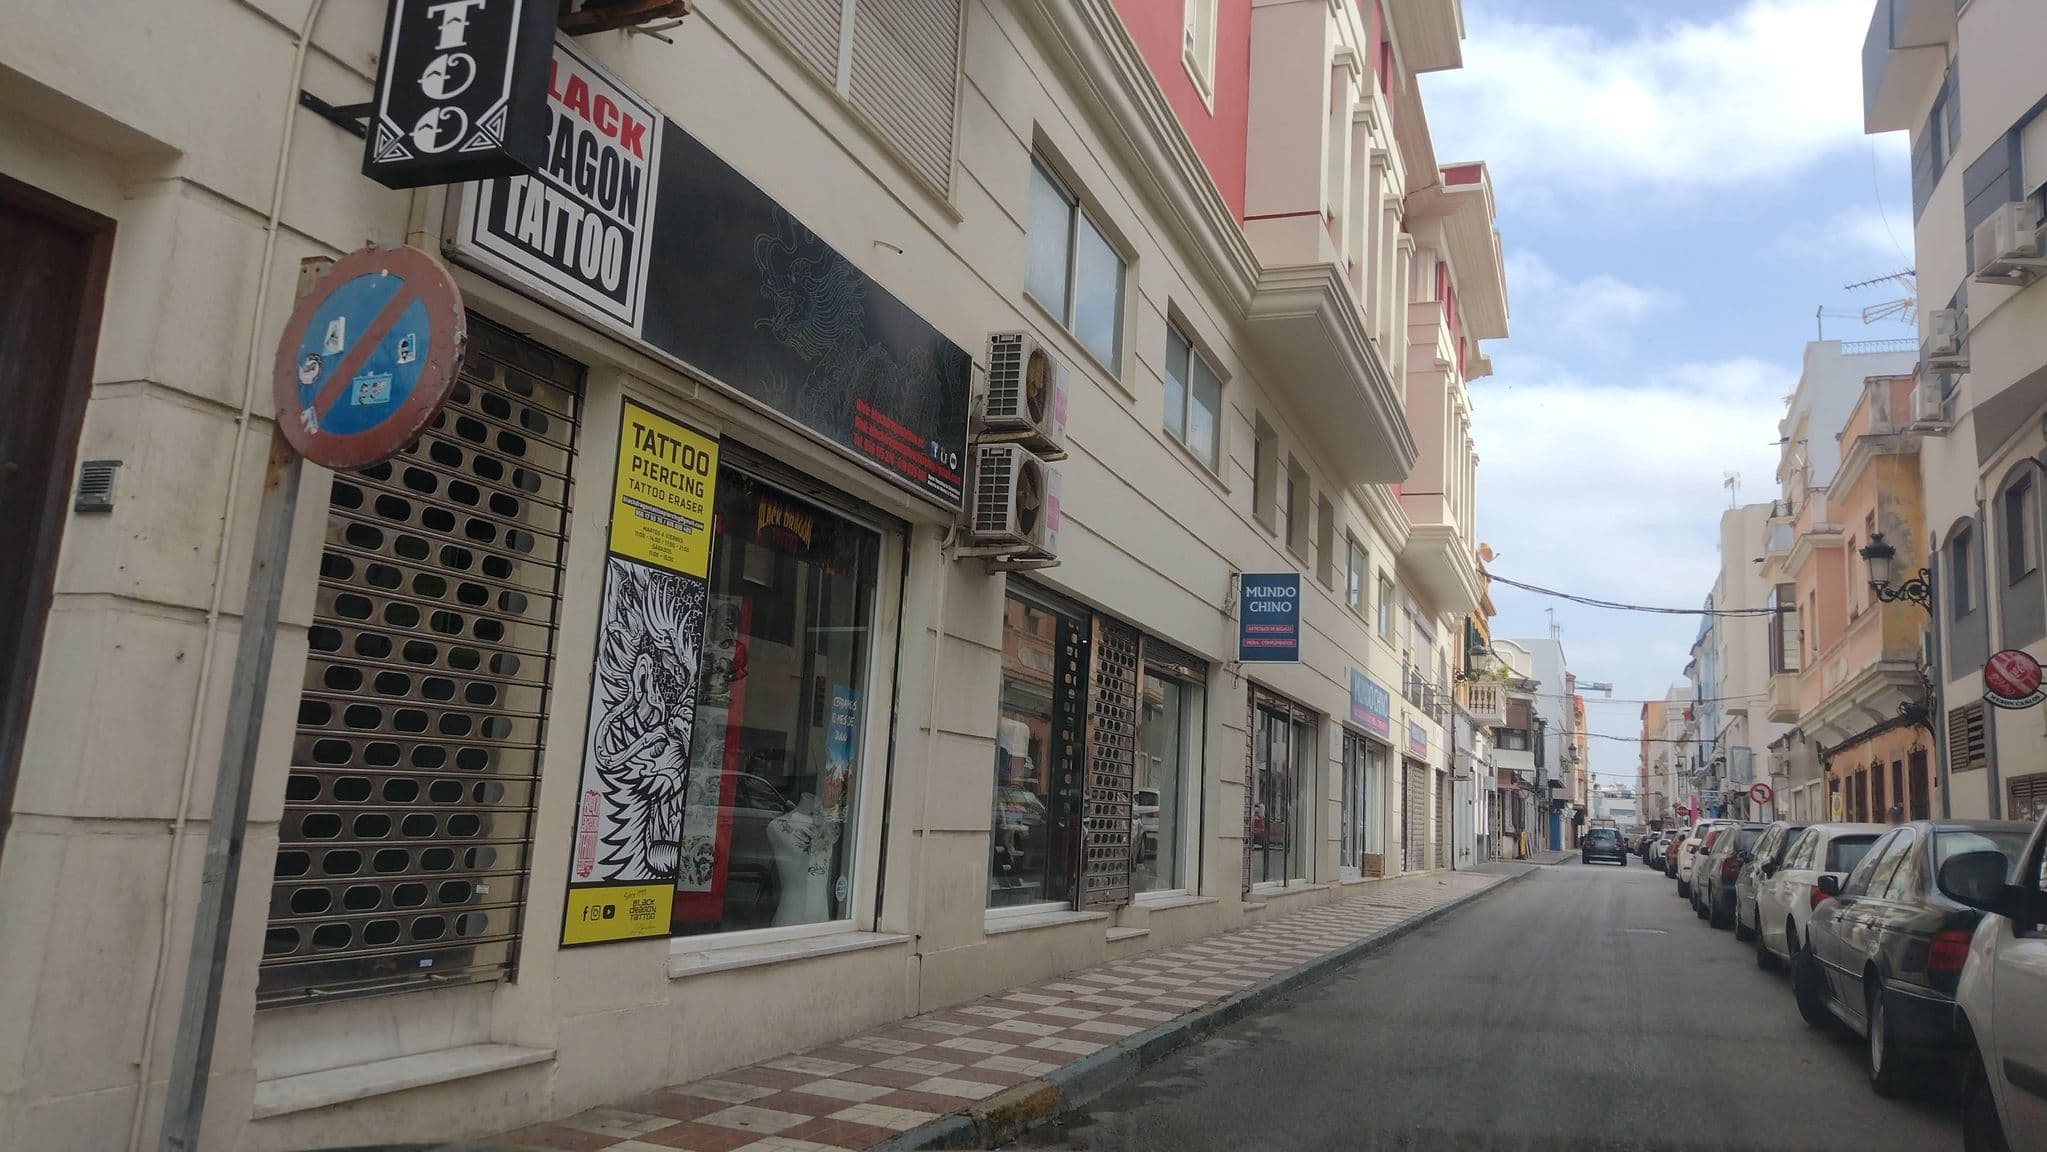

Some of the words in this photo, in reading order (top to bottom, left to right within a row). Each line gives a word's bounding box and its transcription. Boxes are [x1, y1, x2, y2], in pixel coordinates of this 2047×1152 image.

[504, 175, 624, 292] TATTOO
[632, 421, 710, 477] TATTOO
[629, 478, 665, 501] TATTOO
[668, 493, 704, 515] ERASER
[632, 455, 704, 498] PIERCING
[1246, 586, 1297, 598] MUNDO
[1249, 601, 1293, 613] CHINO
